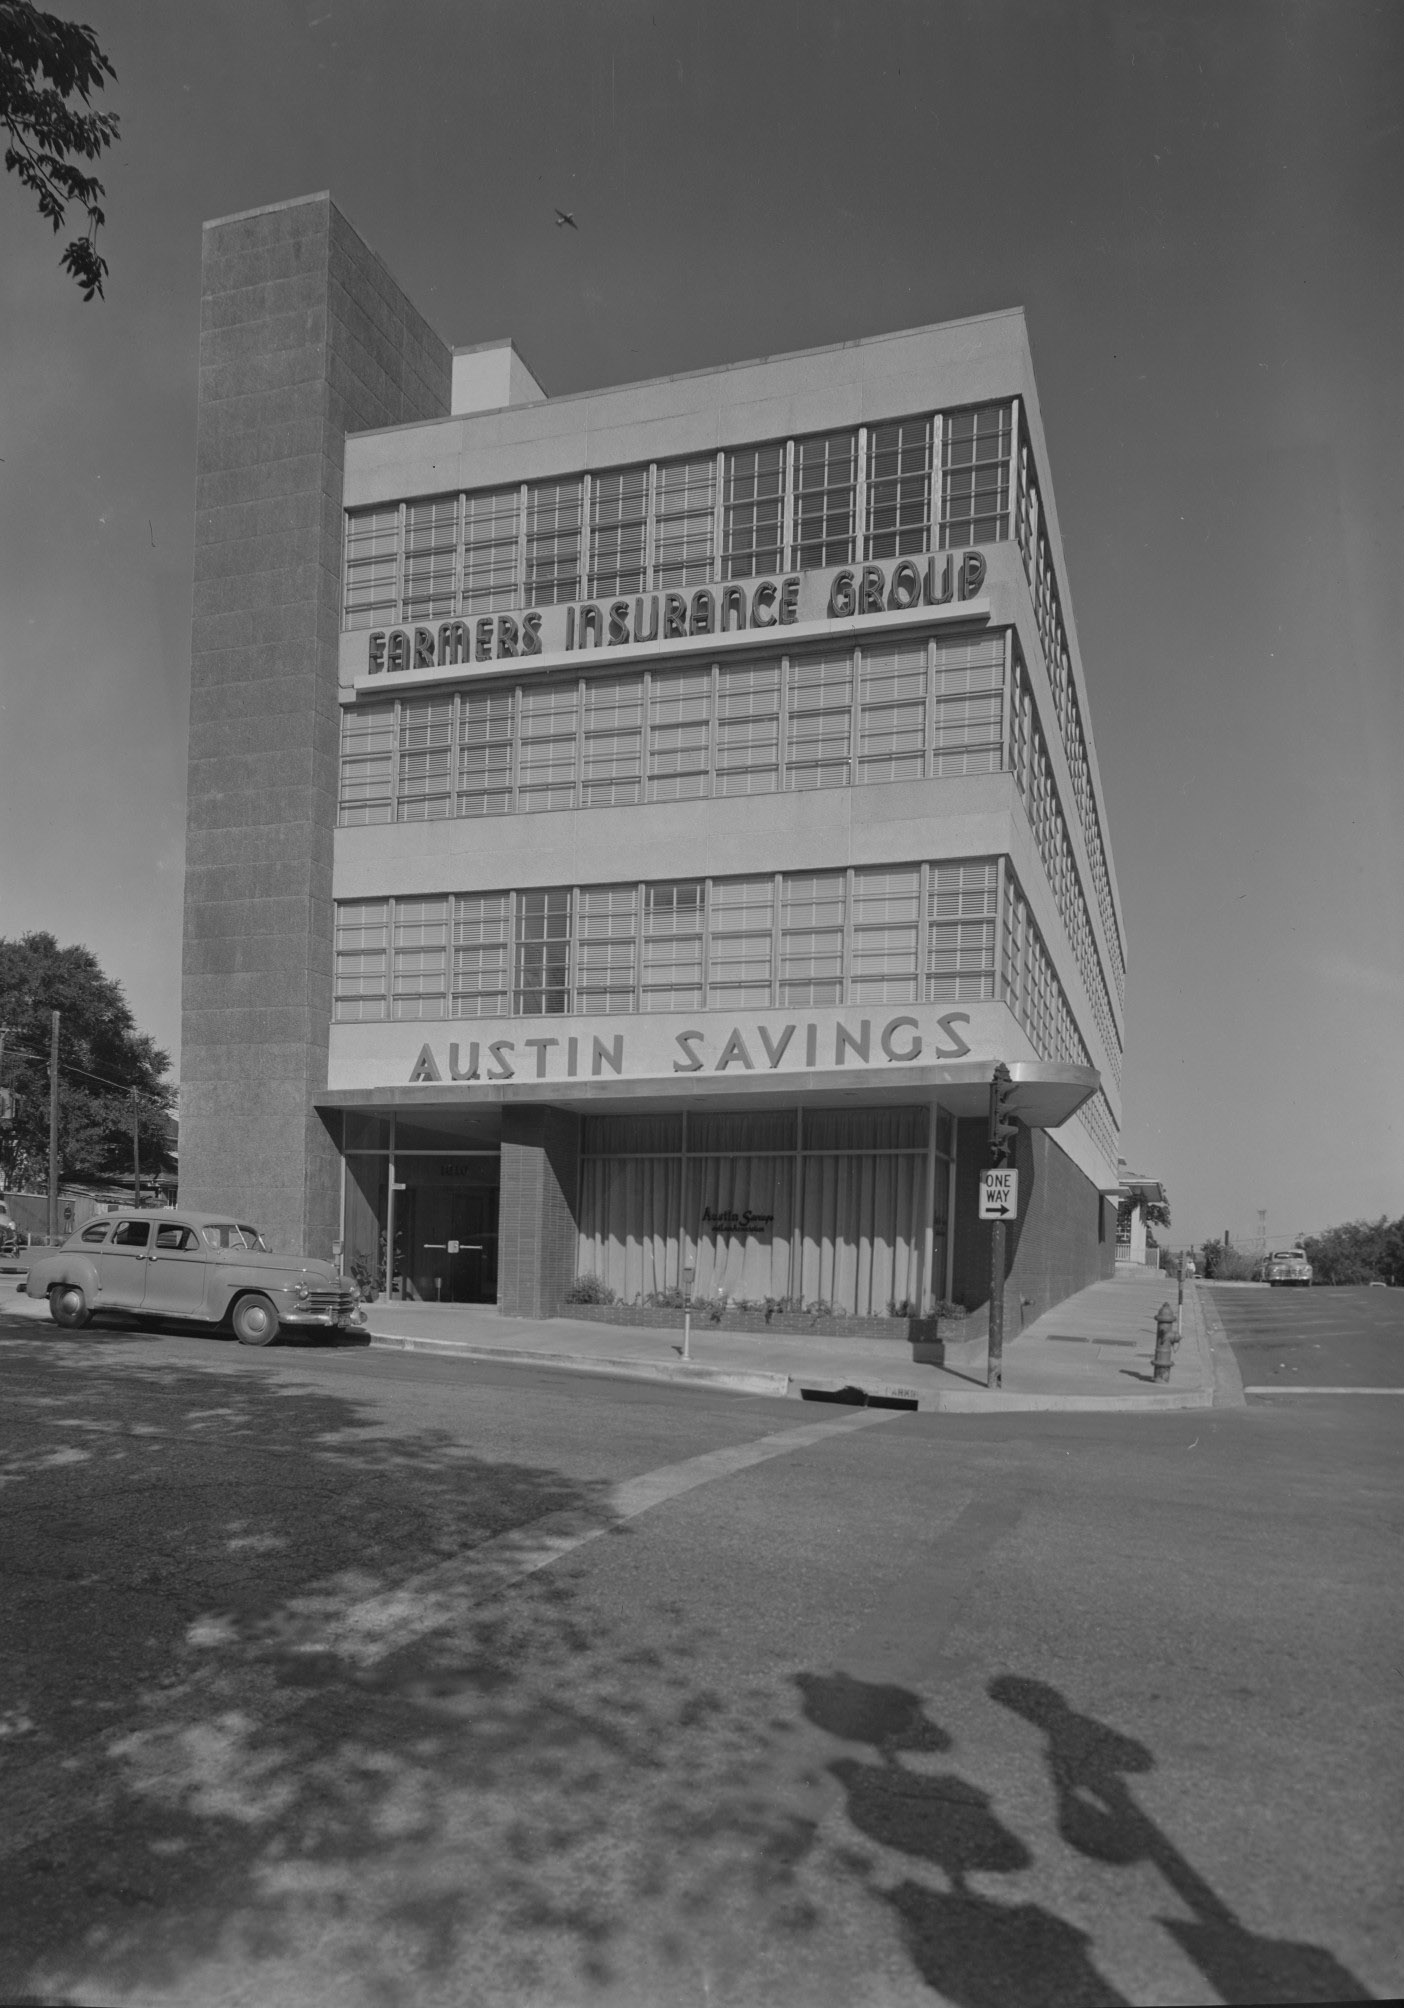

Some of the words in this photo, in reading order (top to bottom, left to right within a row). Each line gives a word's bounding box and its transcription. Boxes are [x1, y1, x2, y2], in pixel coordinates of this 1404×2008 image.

[368, 611, 543, 675] FARMERS
[566, 575, 800, 651] INSURANCE
[828, 551, 987, 618] GROUP
[408, 1034, 624, 1083] AUSTIN
[673, 1011, 972, 1073] SAVINGS
[985, 1174, 1011, 1188] ONE
[986, 1189, 1010, 1203] WAY
